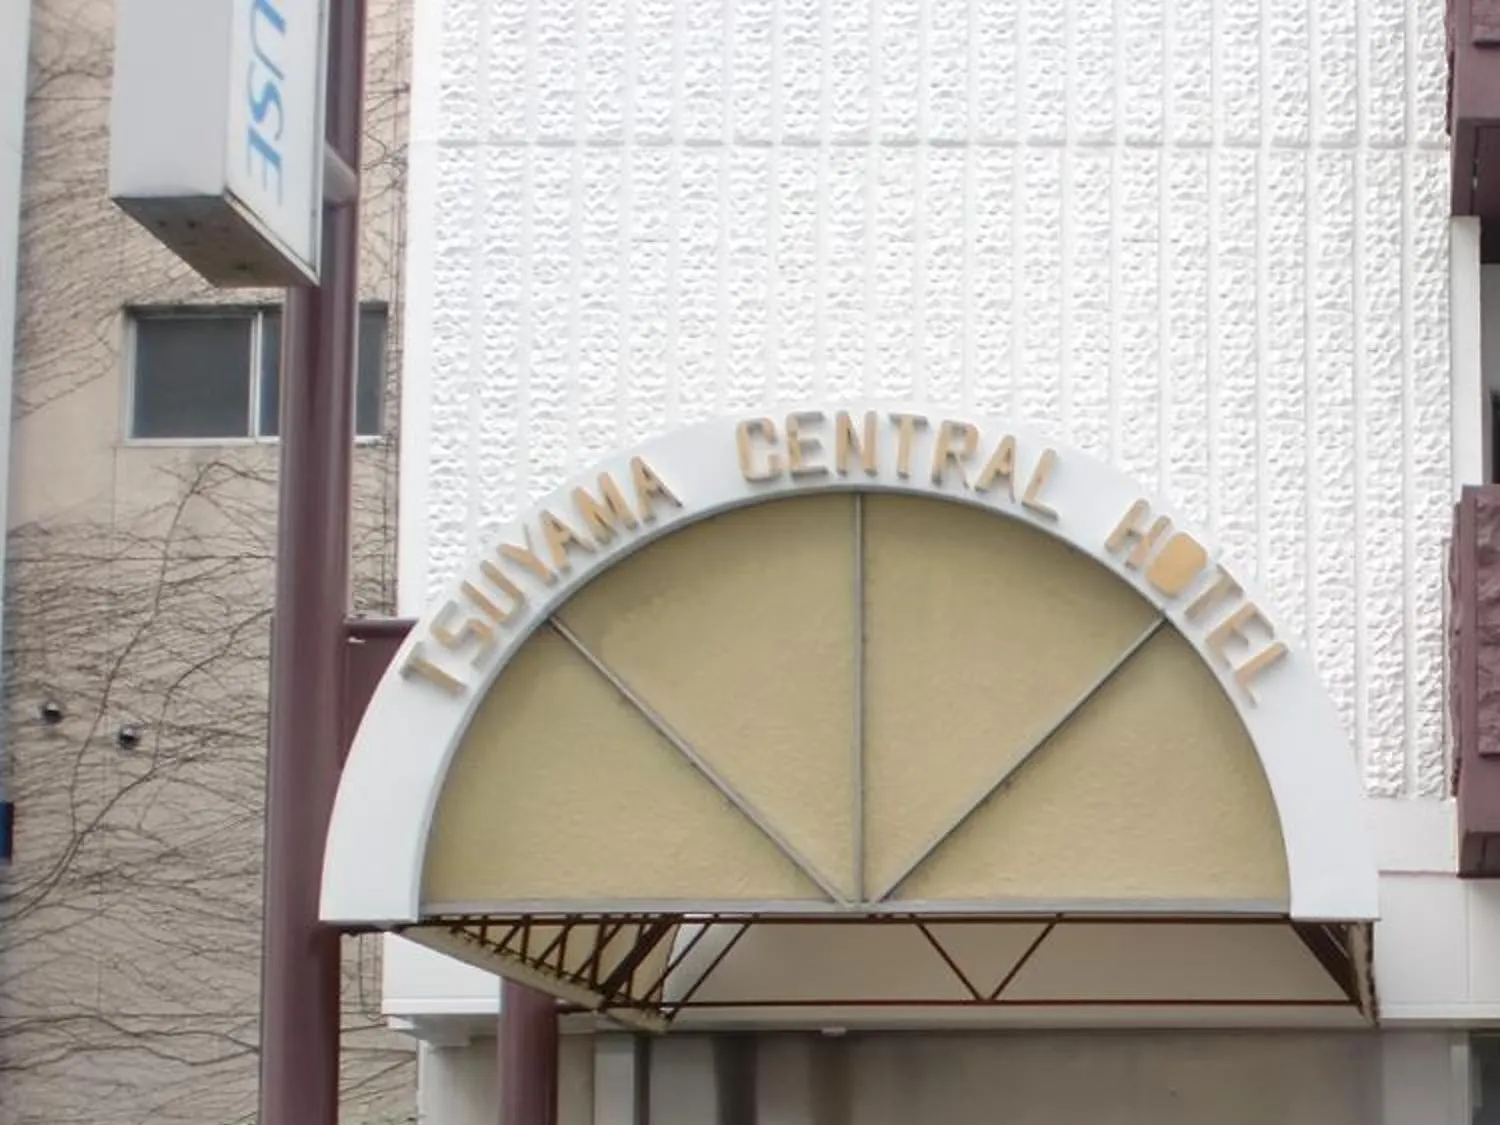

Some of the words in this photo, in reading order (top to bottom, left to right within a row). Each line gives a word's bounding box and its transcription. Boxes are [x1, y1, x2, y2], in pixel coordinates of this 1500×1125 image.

[399, 455, 684, 695] TSUYAMA
[736, 410, 1058, 521] CENTRAL
[1104, 498, 1290, 709] HOTEL
